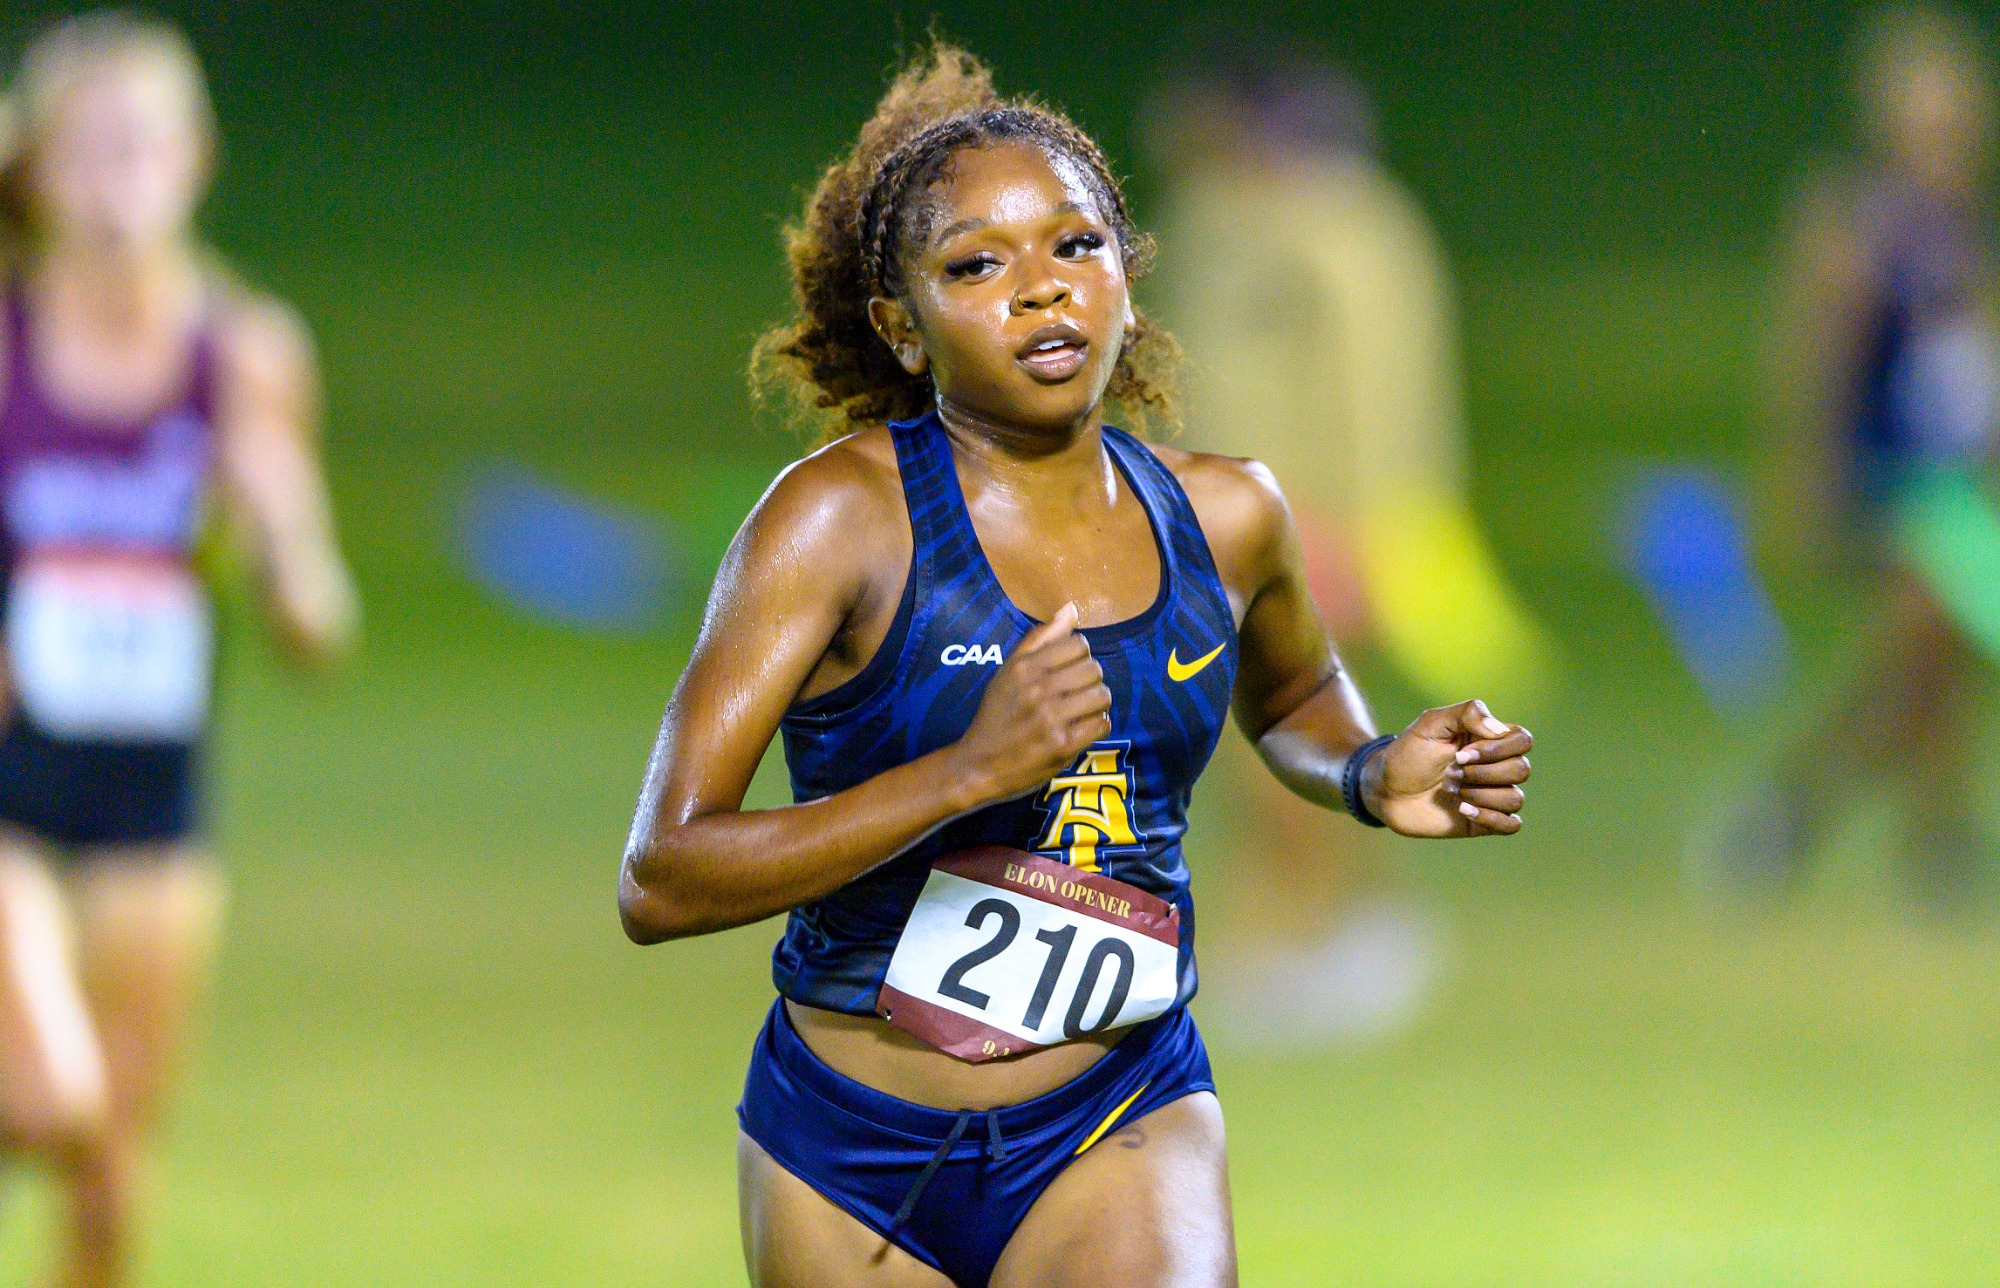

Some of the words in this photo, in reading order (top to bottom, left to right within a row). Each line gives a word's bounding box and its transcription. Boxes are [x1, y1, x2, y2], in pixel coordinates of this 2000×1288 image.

[940, 644, 1004, 666] CAA
[1004, 863, 1057, 893] ELON
[1061, 881, 1131, 919] OPENER
[937, 898, 1135, 1039] 210
